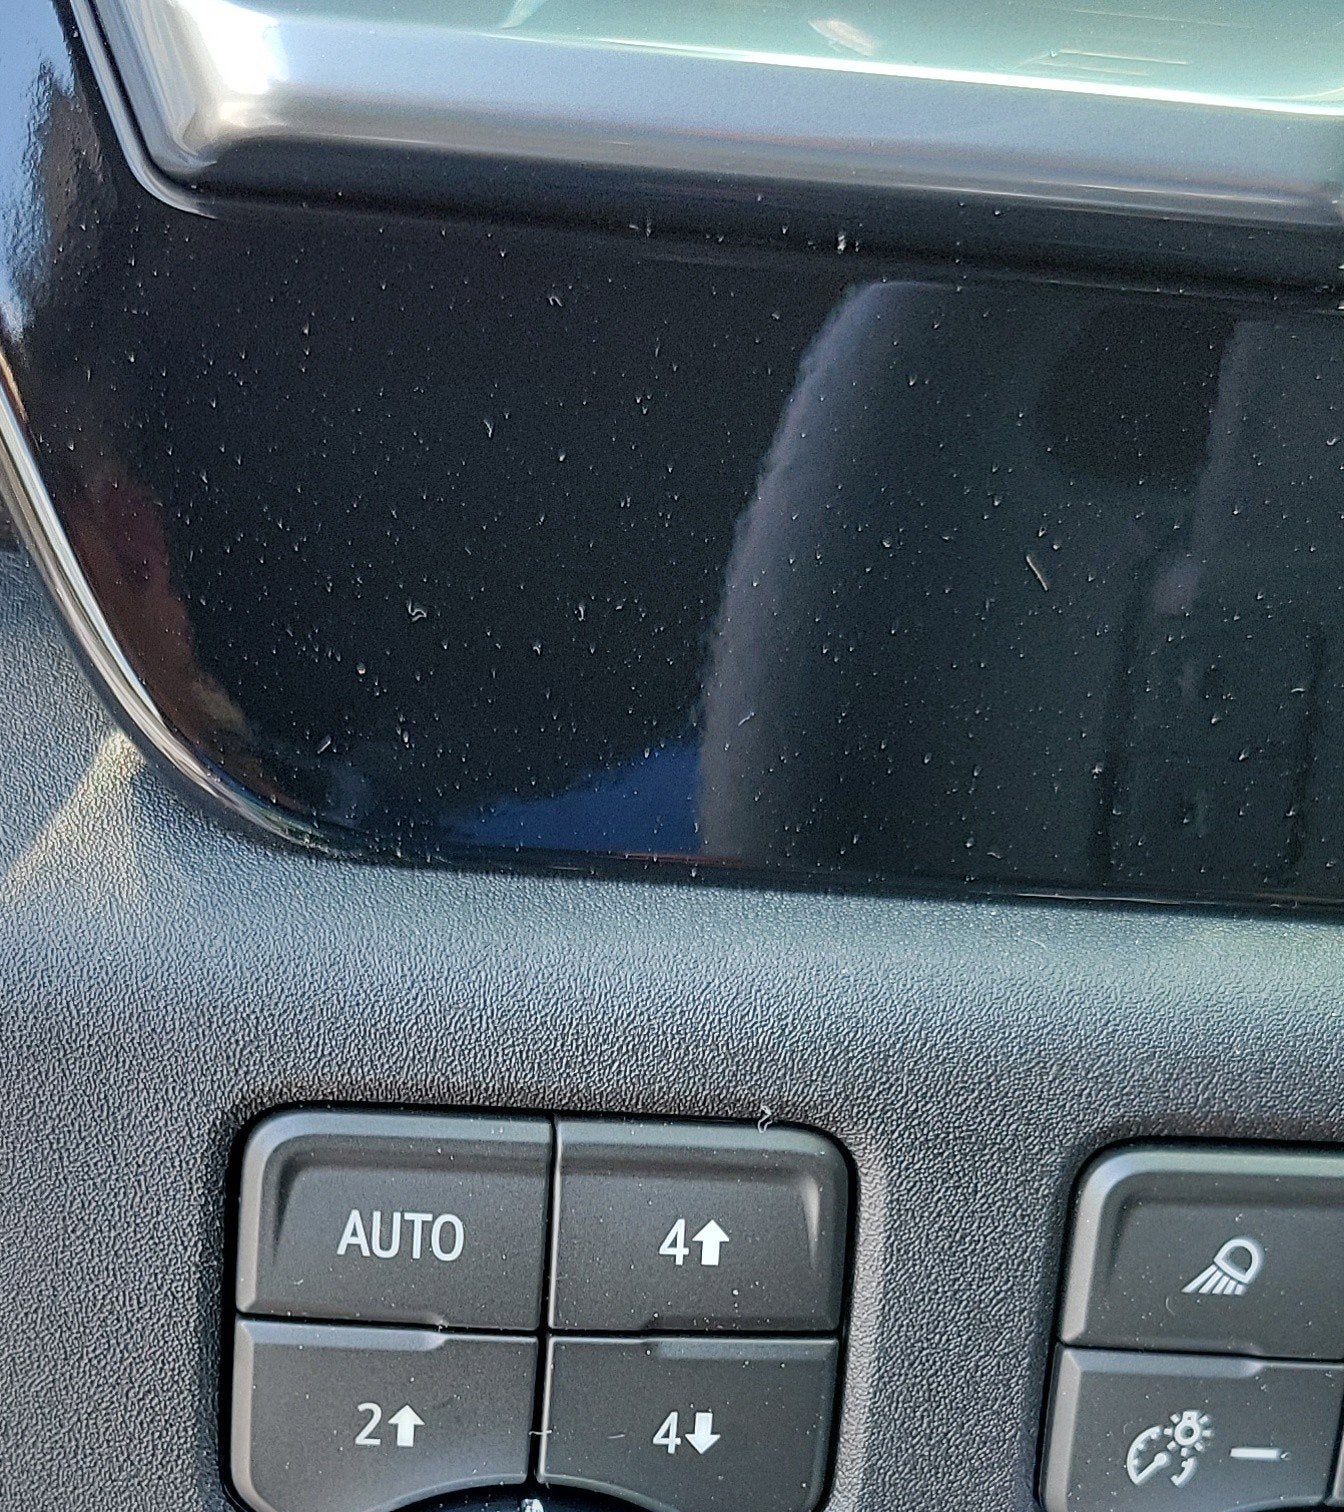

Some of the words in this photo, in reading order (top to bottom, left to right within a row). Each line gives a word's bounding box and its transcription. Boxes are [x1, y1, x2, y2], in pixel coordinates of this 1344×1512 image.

[336, 1209, 465, 1262] AUTO
[658, 1218, 690, 1266] 4
[354, 1401, 383, 1447] 2
[652, 1409, 682, 1455] 4
